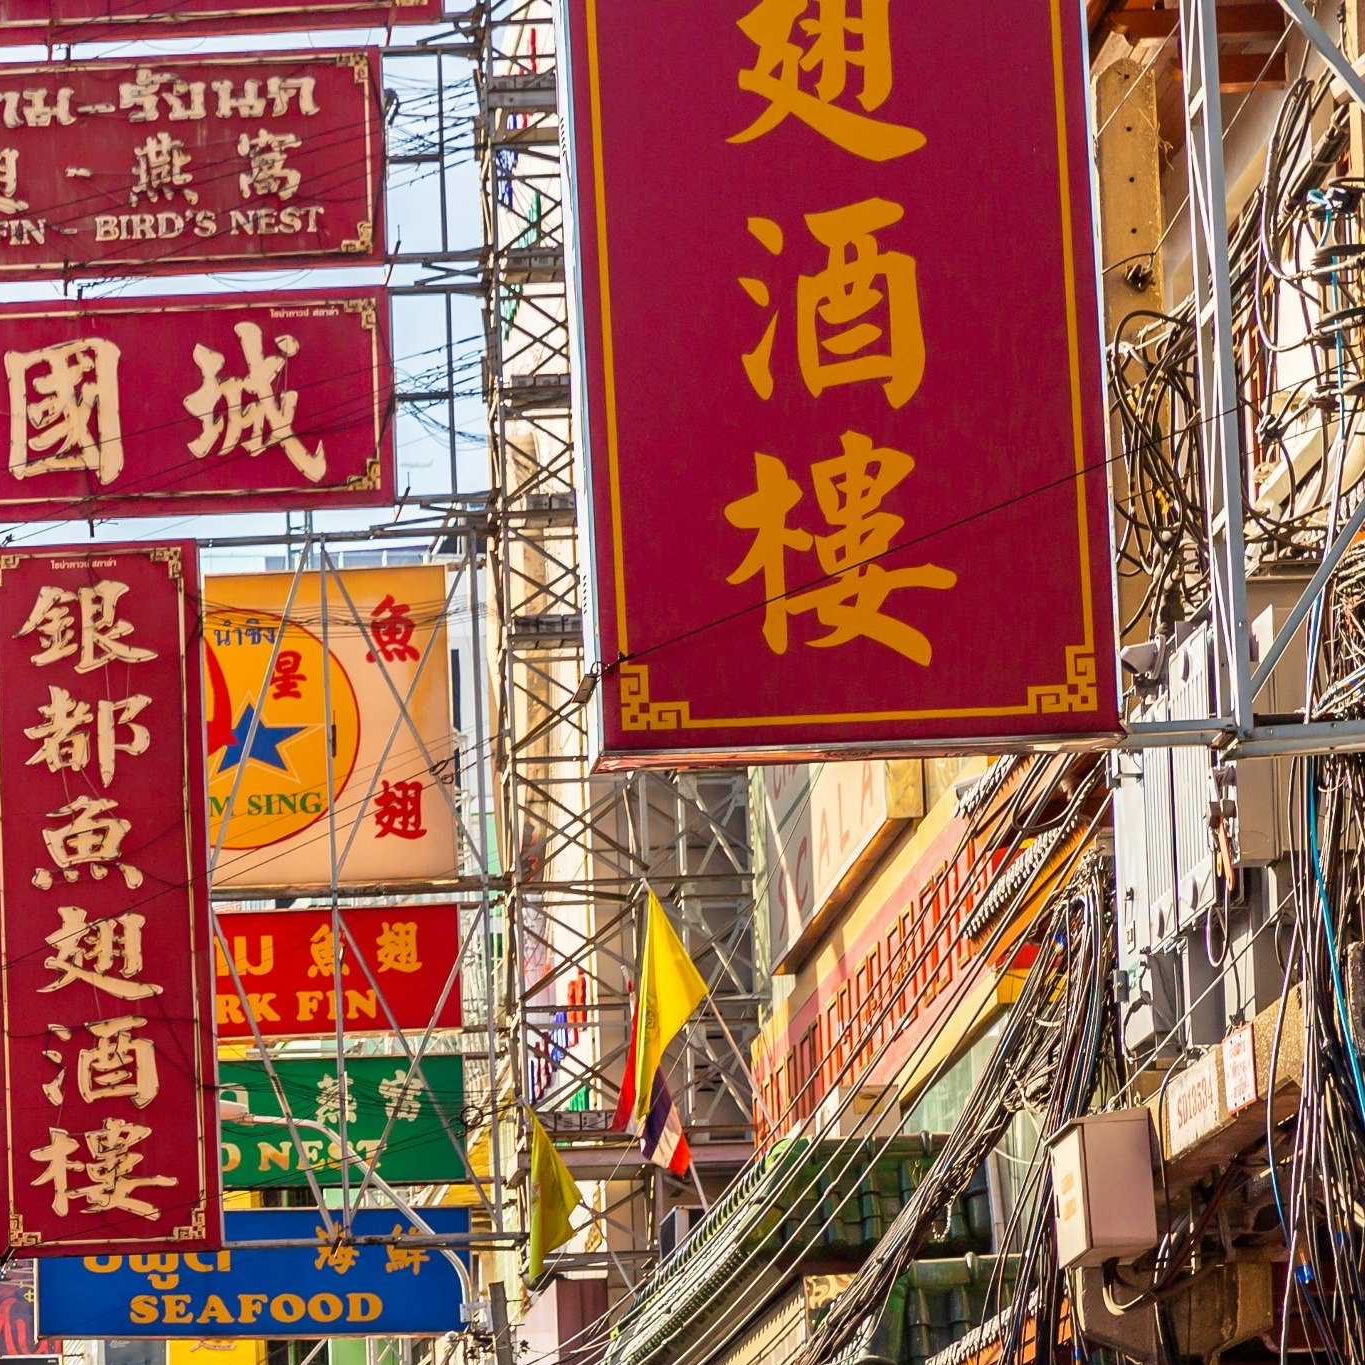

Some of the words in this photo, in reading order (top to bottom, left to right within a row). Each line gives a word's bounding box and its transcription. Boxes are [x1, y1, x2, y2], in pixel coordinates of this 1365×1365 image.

[94, 209, 216, 243] BIRD'S
[229, 206, 324, 236] NEST
[366, 594, 427, 840] 魚翅
[247, 793, 323, 815] SING
[11, 579, 179, 1220] 銀都魚翅酒樓
[308, 922, 422, 978] 魚翅
[296, 989, 377, 1020] FIN
[257, 1139, 387, 1171] NEST
[130, 1293, 383, 1325] SEAFOOD
